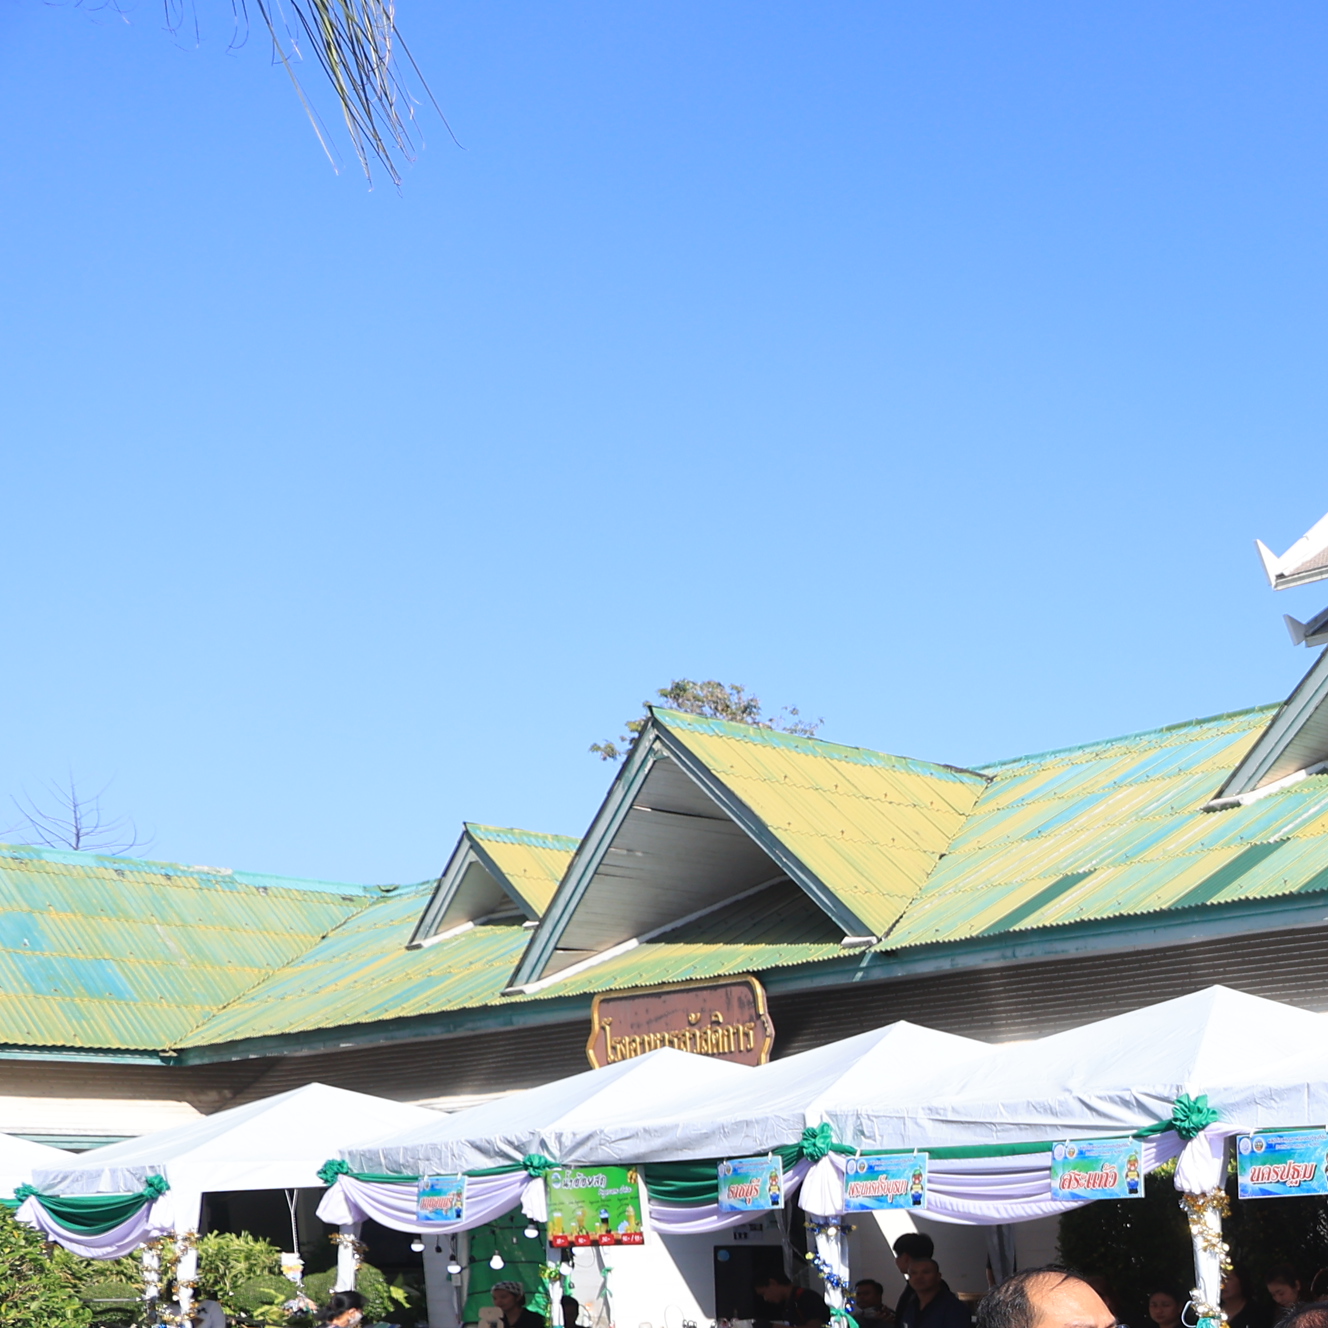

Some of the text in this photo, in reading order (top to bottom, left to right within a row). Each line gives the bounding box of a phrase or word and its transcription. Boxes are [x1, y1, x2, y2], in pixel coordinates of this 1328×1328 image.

[601, 1011, 756, 1063] โรงอาหารสวัสดิการ
[1060, 1163, 1118, 1190] สระแก้ว
[1250, 1160, 1317, 1187] นครปฐม
[727, 1178, 762, 1206] ราชบุรี
[849, 1174, 908, 1204] พระนครศรีอยุธยา
